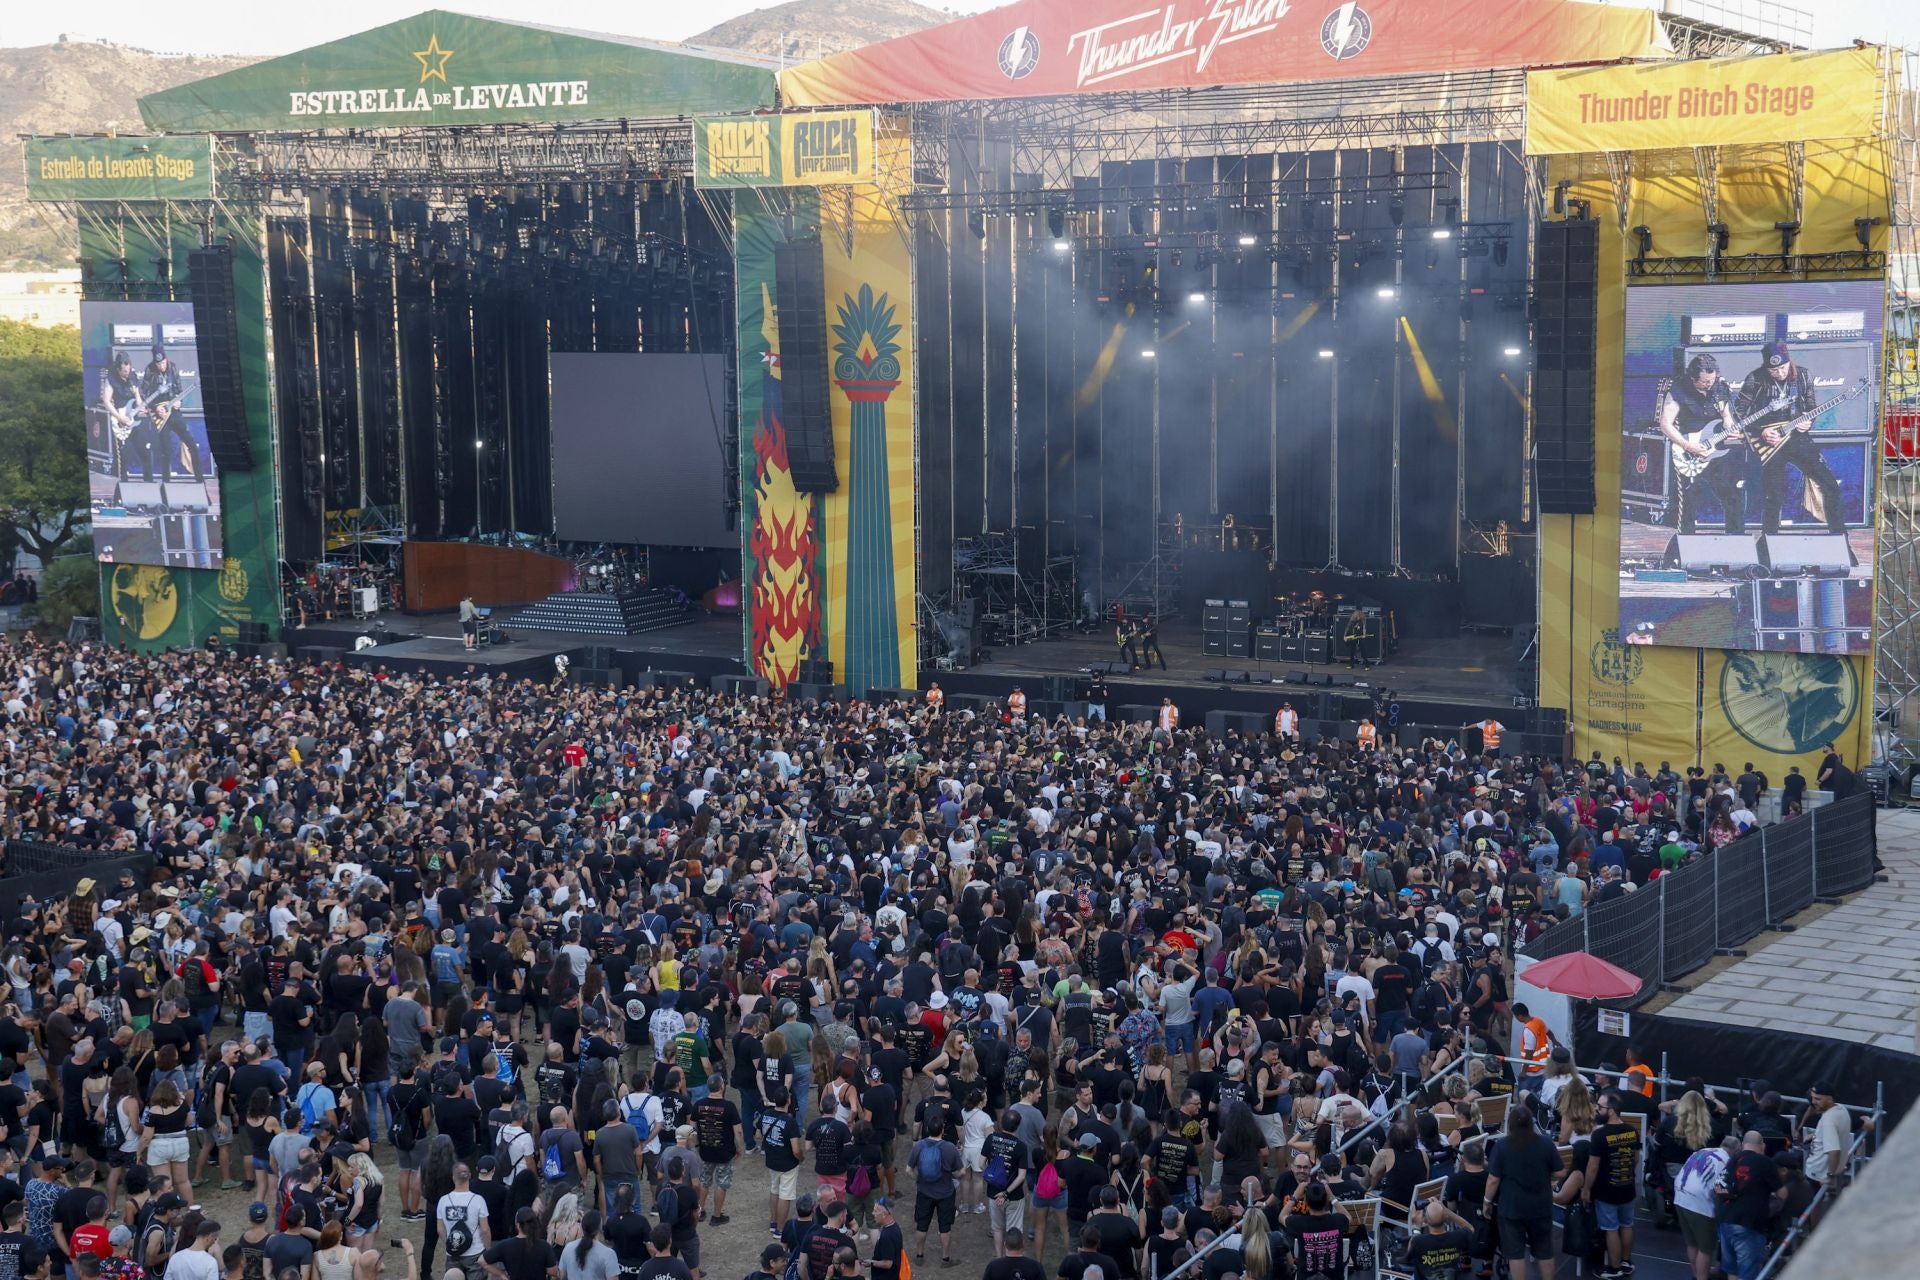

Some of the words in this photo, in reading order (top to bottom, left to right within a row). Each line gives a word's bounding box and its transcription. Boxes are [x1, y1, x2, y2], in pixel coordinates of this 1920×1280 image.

[1066, 4, 1203, 88] Thunder
[289, 88, 432, 115] ESTRELLA
[433, 93, 451, 105] DE
[452, 80, 588, 110] LEVANTE
[1579, 89, 1672, 124] Thunder
[1678, 84, 1739, 118] Bitch
[1744, 82, 1814, 117] Stage
[707, 120, 770, 178] ROCK
[794, 118, 858, 178] ROCK
[802, 156, 850, 172] IMPERIUM
[40, 155, 85, 179] Estrella
[88, 155, 103, 179] de
[105, 155, 153, 178] Levante
[155, 154, 194, 181] Stage
[1587, 697, 1645, 711] Cartagena
